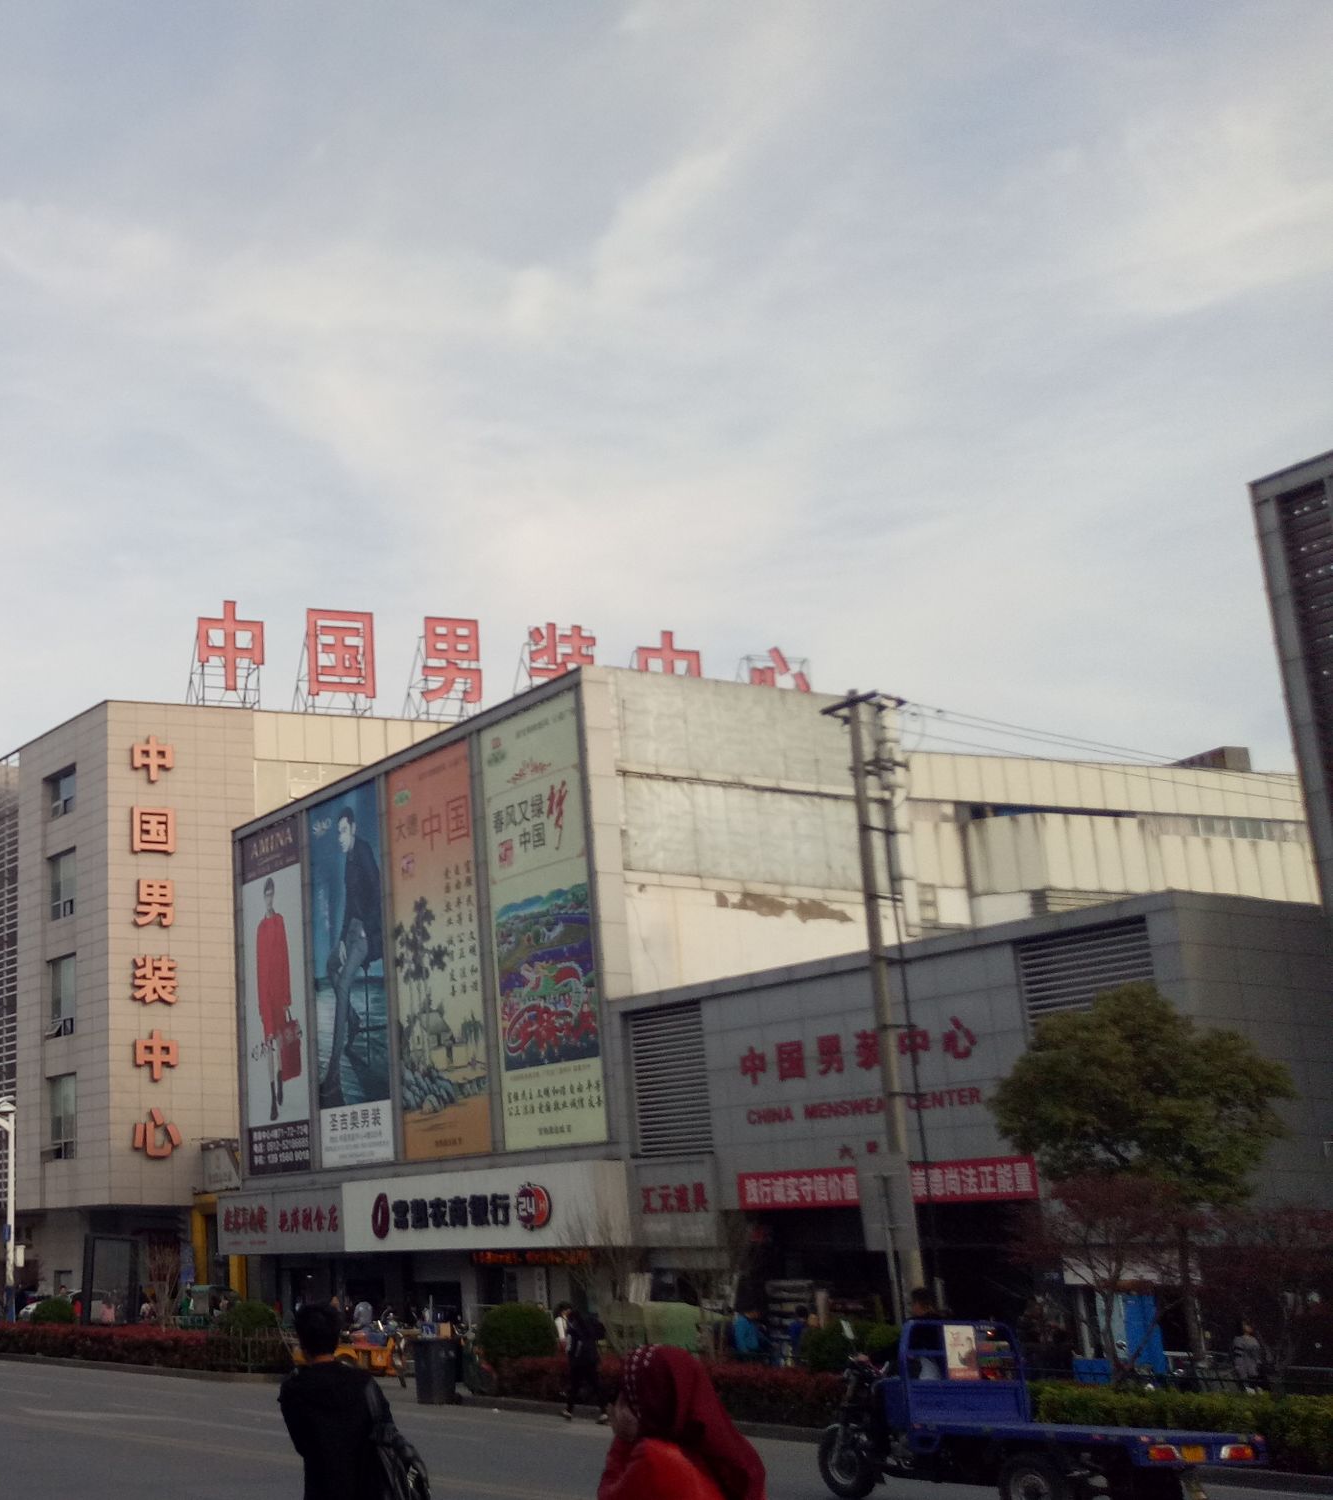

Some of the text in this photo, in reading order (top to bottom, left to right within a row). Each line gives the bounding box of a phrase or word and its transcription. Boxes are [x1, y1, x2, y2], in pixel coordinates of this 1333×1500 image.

[491, 793, 545, 835] 春风又绿
[519, 822, 546, 853] 中国
[130, 735, 182, 1159] 中国男装中心
[740, 1015, 979, 1086] 中国男装中心
[746, 1105, 795, 1125] CHINA
[803, 1096, 888, 1121] MENSWEA
